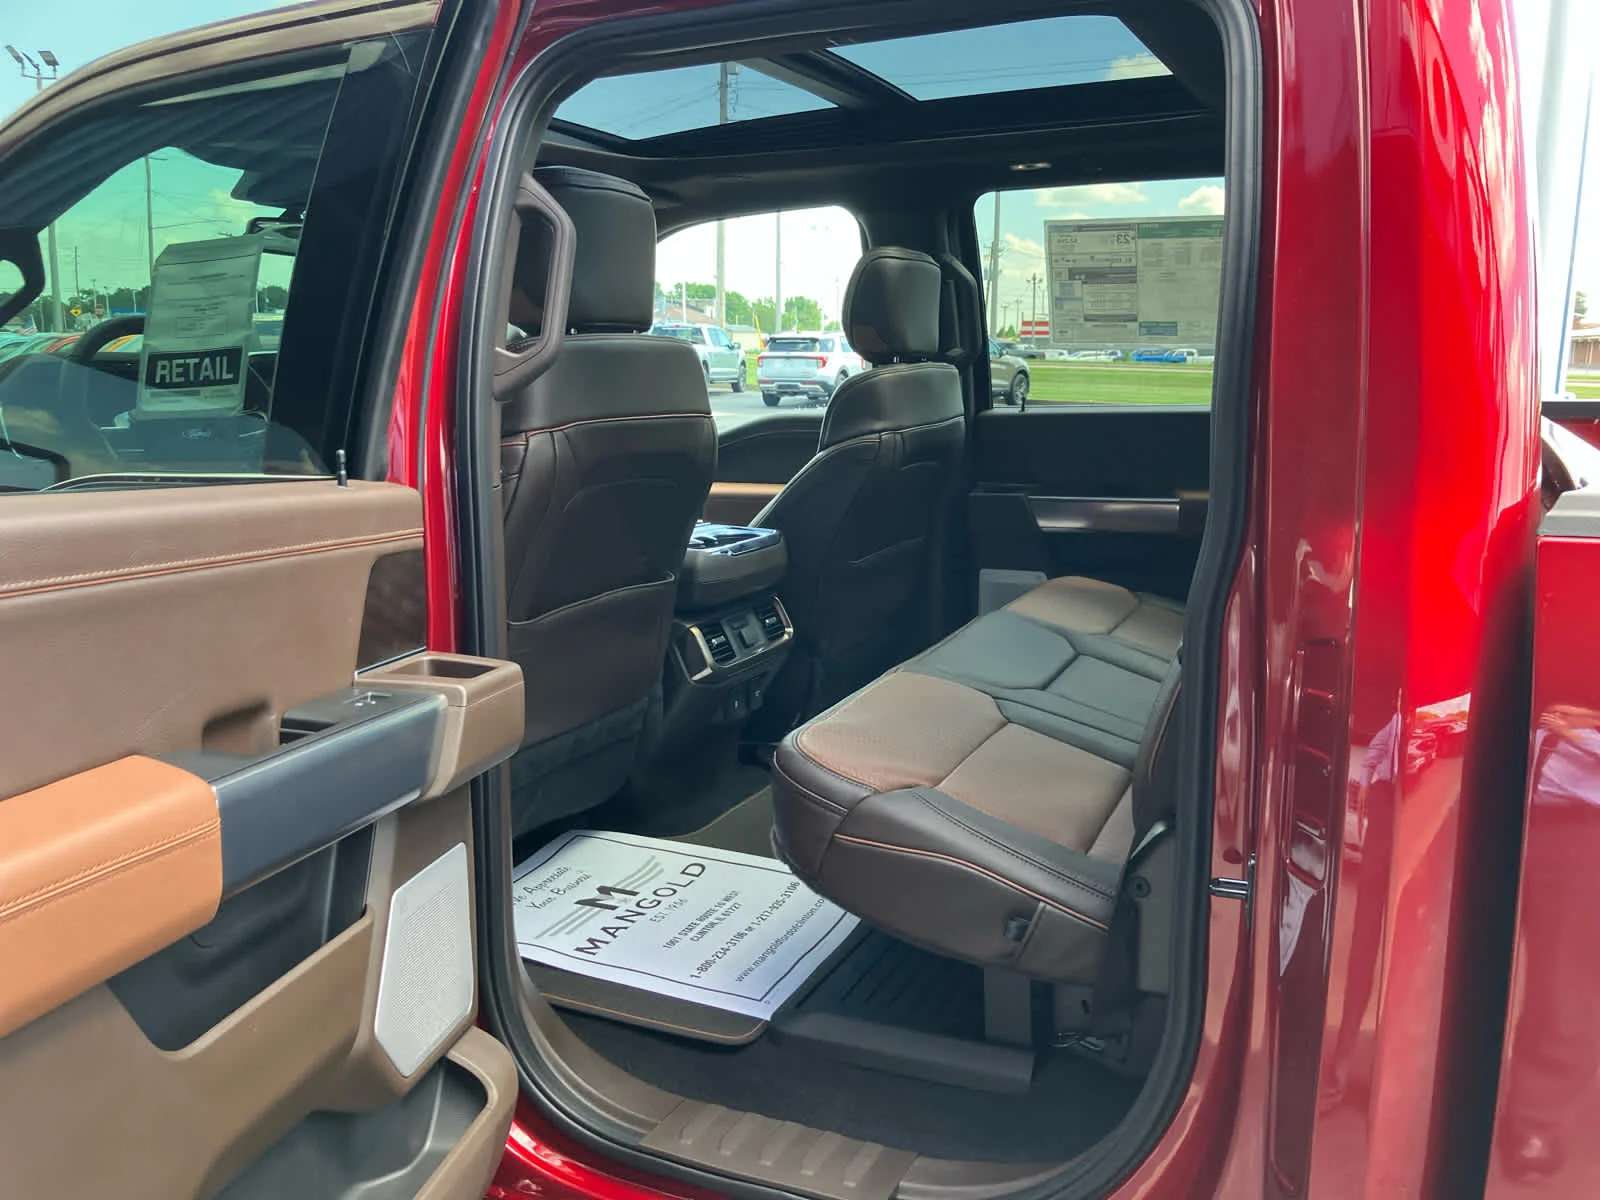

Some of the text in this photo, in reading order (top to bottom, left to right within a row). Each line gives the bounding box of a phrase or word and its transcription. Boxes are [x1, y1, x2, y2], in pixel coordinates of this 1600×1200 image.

[155, 355, 234, 384] RETAIL
[573, 862, 706, 956] MANGOLD
[678, 921, 700, 937] STATE
[689, 930, 749, 978] 1-800-234-3106
[735, 898, 825, 982] www.mangoldfordofclinton.co
